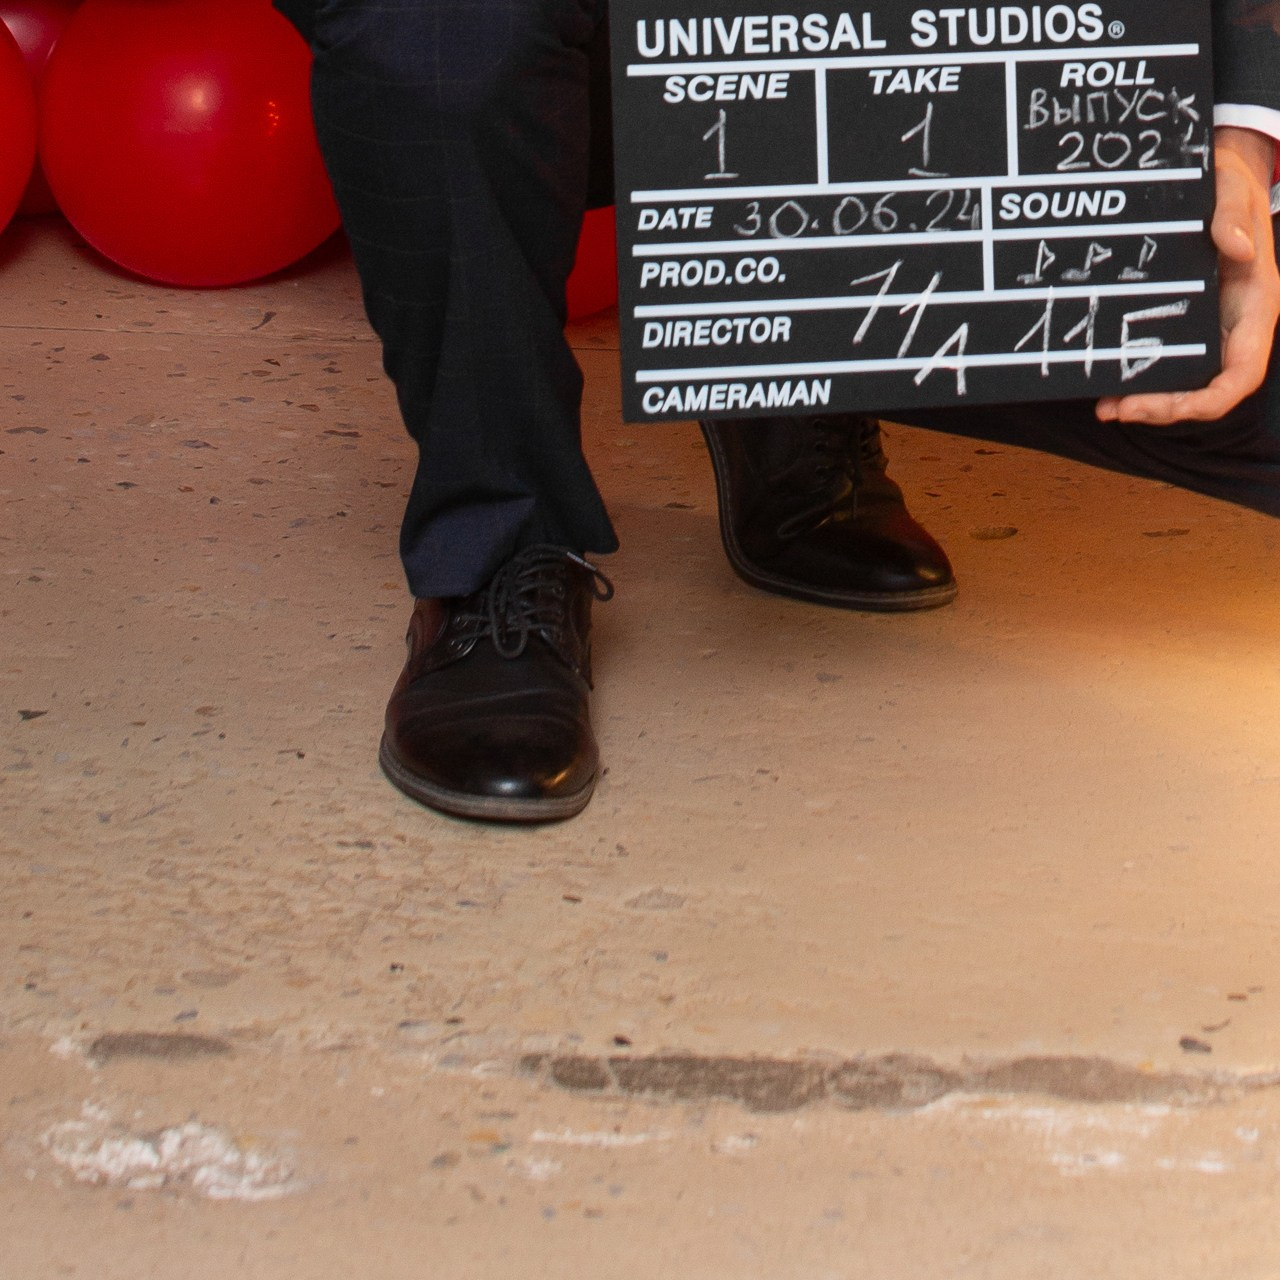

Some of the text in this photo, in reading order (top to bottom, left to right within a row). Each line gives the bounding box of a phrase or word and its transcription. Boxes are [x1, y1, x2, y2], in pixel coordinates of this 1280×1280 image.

[636, 12, 888, 58] UNIVERSAL
[663, 72, 791, 104] SCENE
[868, 65, 962, 95] TAKE
[1059, 60, 1156, 88] ROLL
[702, 108, 740, 180] 1
[901, 101, 949, 178] 1
[1056, 121, 1210, 172] 2024
[637, 205, 715, 231] DATE
[733, 189, 980, 239] 30.06.24
[999, 189, 1127, 221] SOUND
[639, 256, 787, 289] PROD.CO.
[642, 315, 792, 349] DIRECTOR
[642, 378, 832, 415] CAMERAMAN
